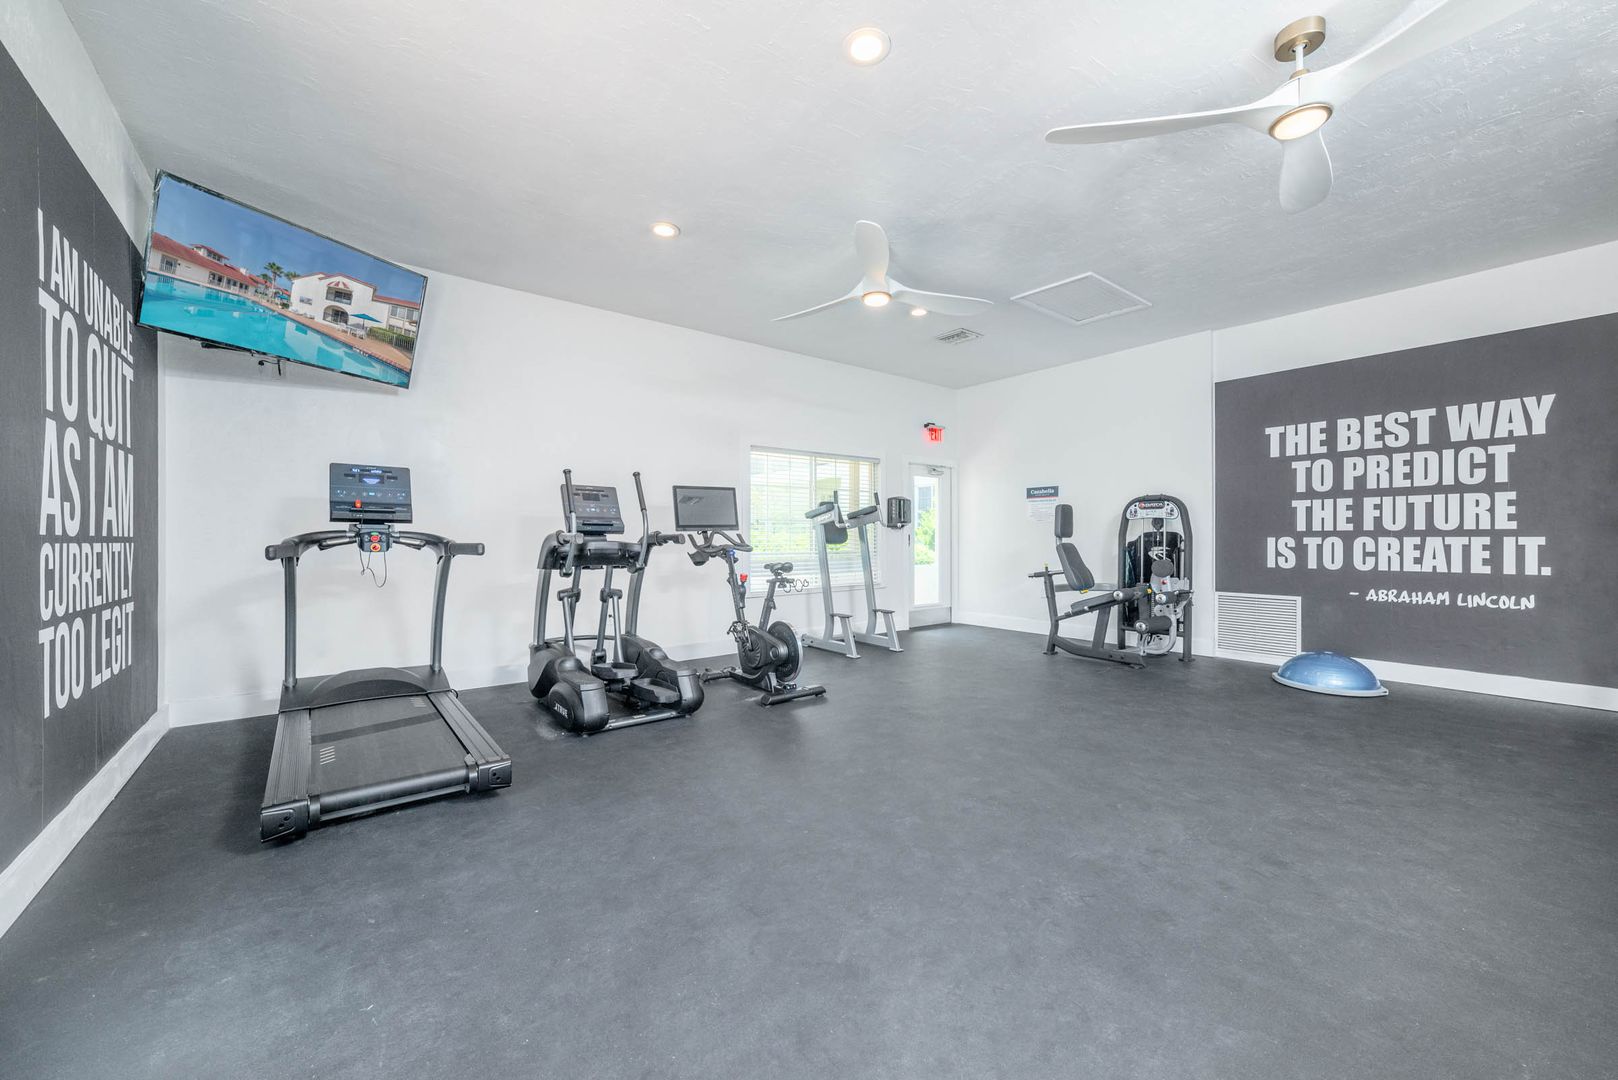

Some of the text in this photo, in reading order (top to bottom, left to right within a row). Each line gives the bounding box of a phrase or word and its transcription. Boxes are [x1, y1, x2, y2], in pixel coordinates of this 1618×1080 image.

[38, 207, 133, 365] I AM UNABLE
[39, 286, 134, 449] TO QUIT
[1265, 393, 1556, 458] THE BEST WAY
[39, 417, 134, 538] AS I AM
[1291, 443, 1516, 493] TO PREDICT
[1291, 491, 1518, 532] THE FUTURE
[39, 542, 134, 622] CURRENTLY
[1266, 536, 1552, 576] IS TO CREATE IT.
[1365, 588, 1450, 606] ABRAHAM
[1456, 592, 1536, 611] LINCOLN
[38, 602, 134, 719] TOO LEGIT
